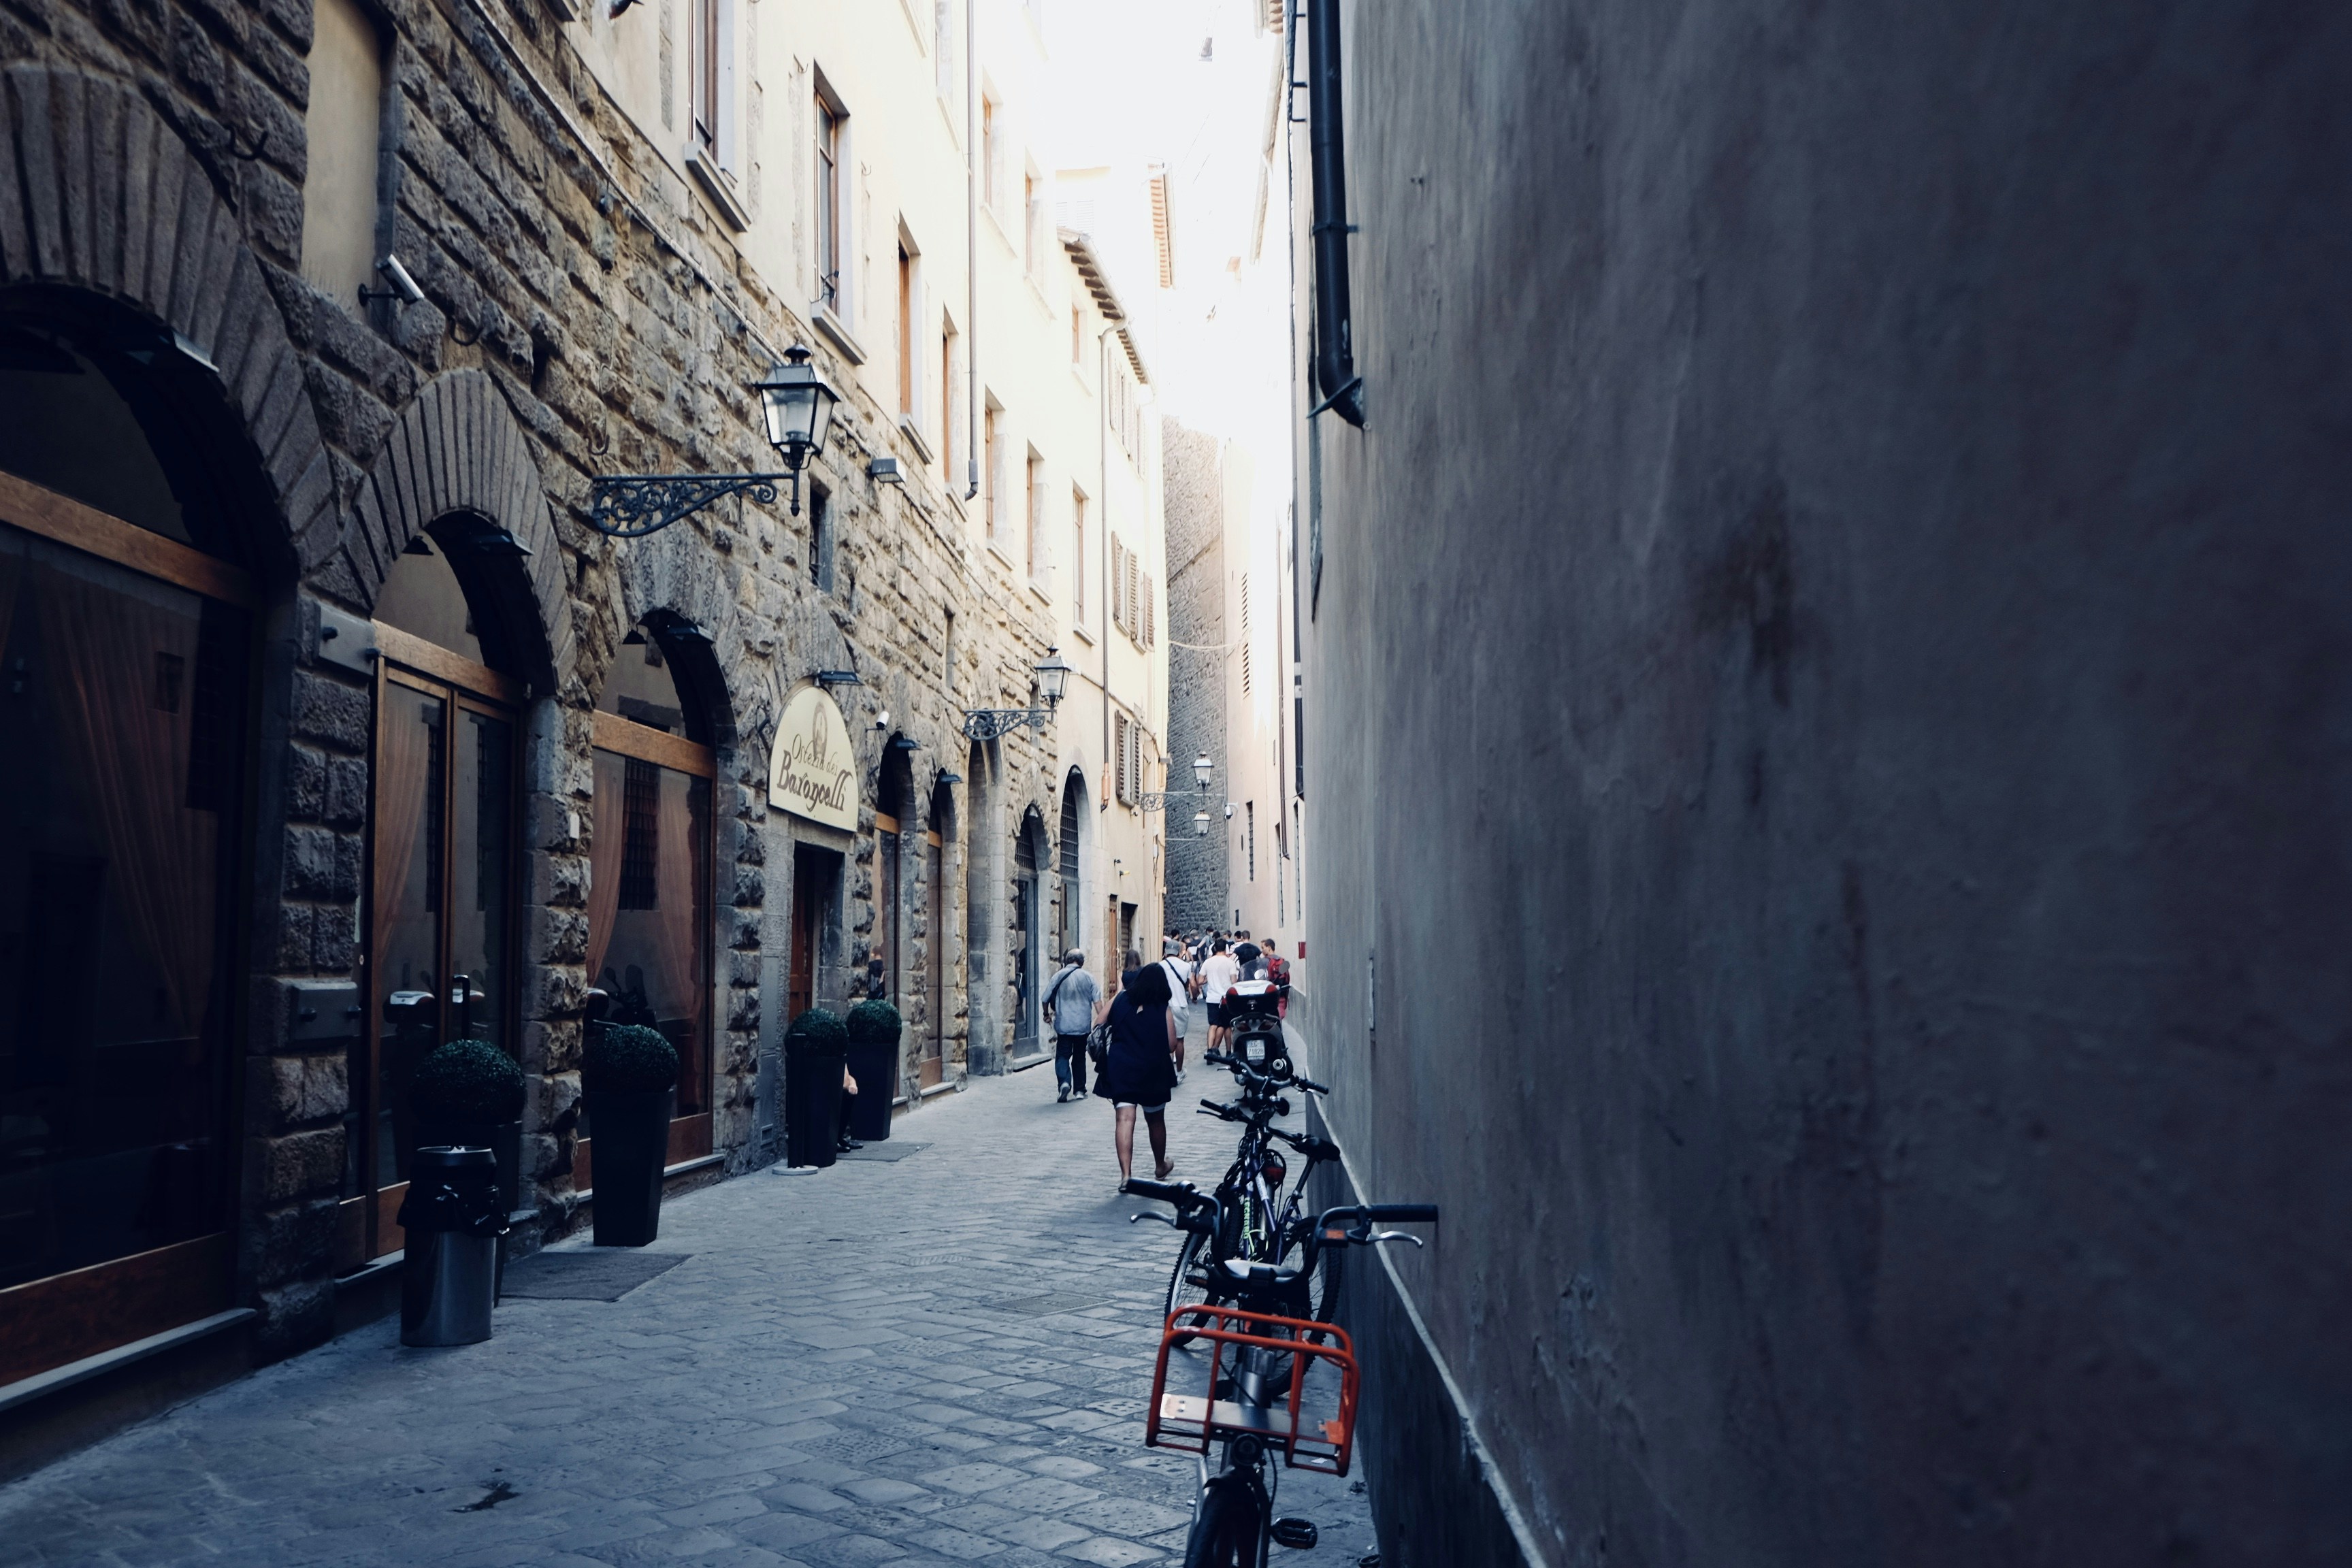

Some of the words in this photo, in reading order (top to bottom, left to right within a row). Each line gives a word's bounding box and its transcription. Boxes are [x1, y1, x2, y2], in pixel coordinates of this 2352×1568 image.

[777, 749, 853, 812] Baroncelli
[792, 734, 825, 770] Osteria
[826, 751, 838, 776] dei
